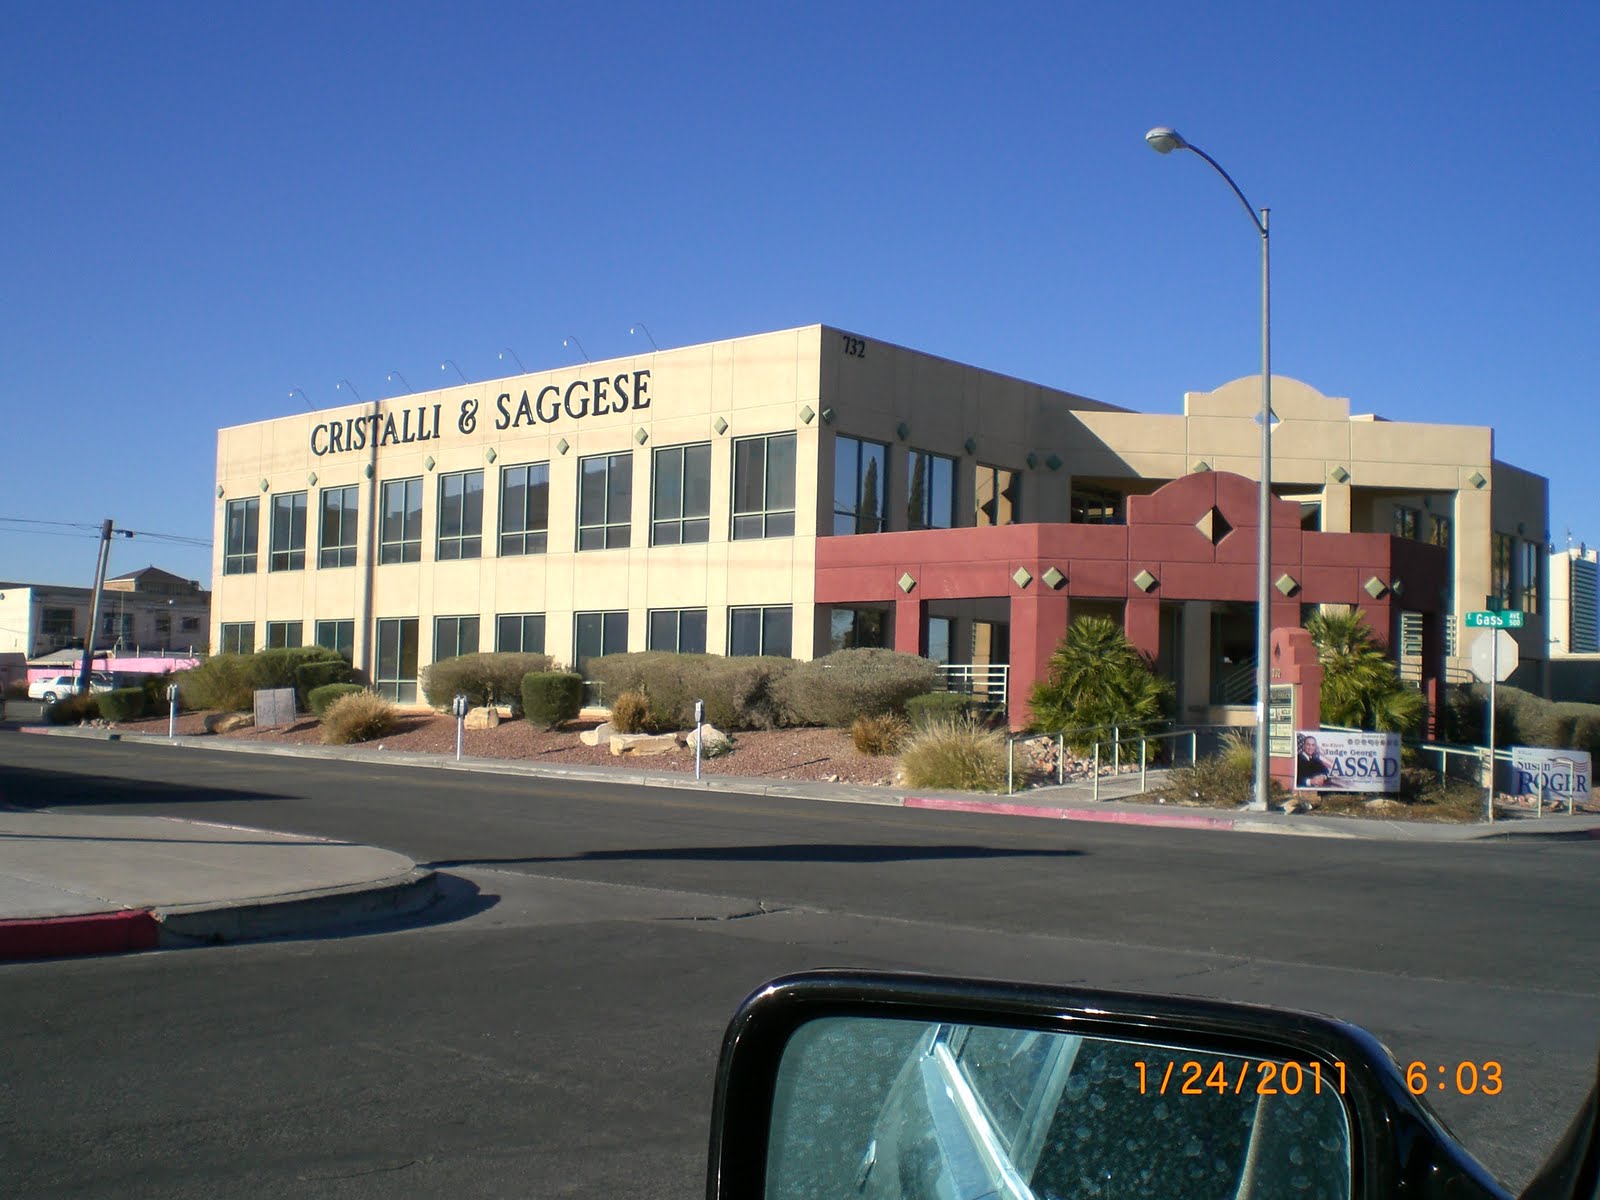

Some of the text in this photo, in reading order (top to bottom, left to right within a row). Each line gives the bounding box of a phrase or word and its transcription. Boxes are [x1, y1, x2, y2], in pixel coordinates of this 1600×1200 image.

[842, 335, 866, 358] 732
[311, 369, 652, 456] CRISTALLI & SAGGESE
[1476, 613, 1503, 626] Gass
[1510, 612, 1521, 620] AVE
[1325, 748, 1377, 757] Judge George
[1329, 757, 1398, 778] ASSAD
